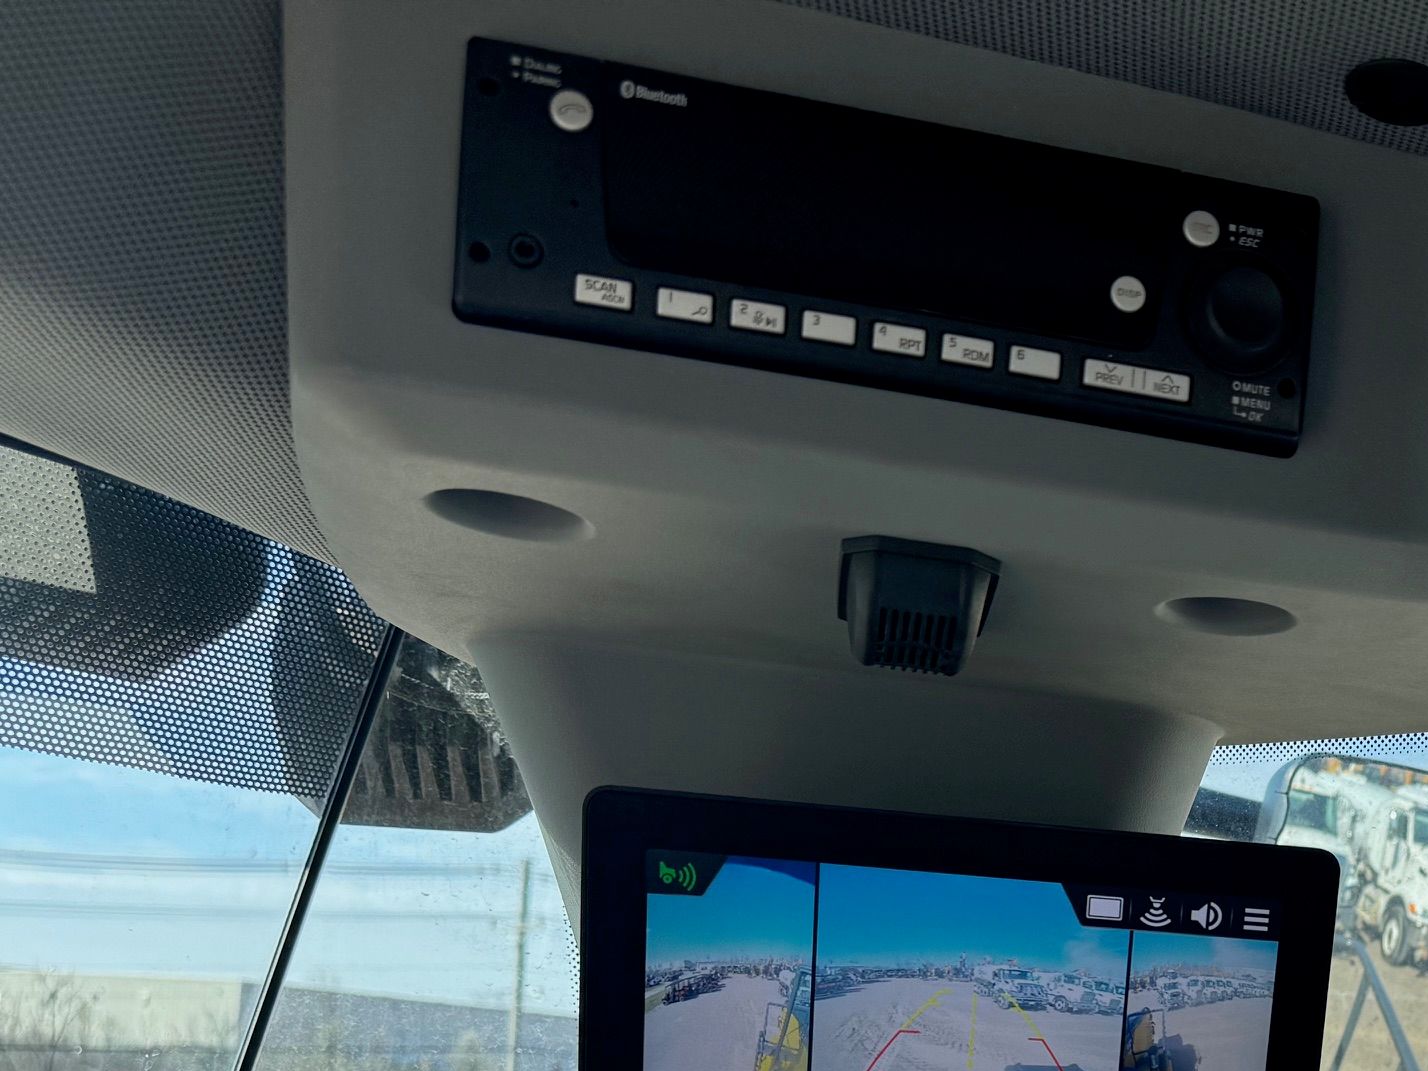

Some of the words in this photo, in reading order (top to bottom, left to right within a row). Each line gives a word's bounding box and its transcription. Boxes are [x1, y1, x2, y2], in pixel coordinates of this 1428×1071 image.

[635, 83, 688, 107] Bluetooth
[1237, 223, 1264, 238] PWR
[1237, 236, 1260, 248] ESC
[584, 278, 617, 293] SCAN
[739, 303, 748, 315] 2
[812, 314, 821, 326] 3
[878, 324, 888, 337] 4
[899, 337, 922, 353] RPT
[948, 336, 957, 349] 5
[962, 347, 990, 364] RDM
[1016, 349, 1025, 361] 6
[1095, 371, 1124, 386] PREV
[1153, 382, 1181, 397] NEXT
[1242, 382, 1271, 397] MUTE
[1240, 396, 1271, 411] MENU
[1247, 411, 1264, 423] OK
